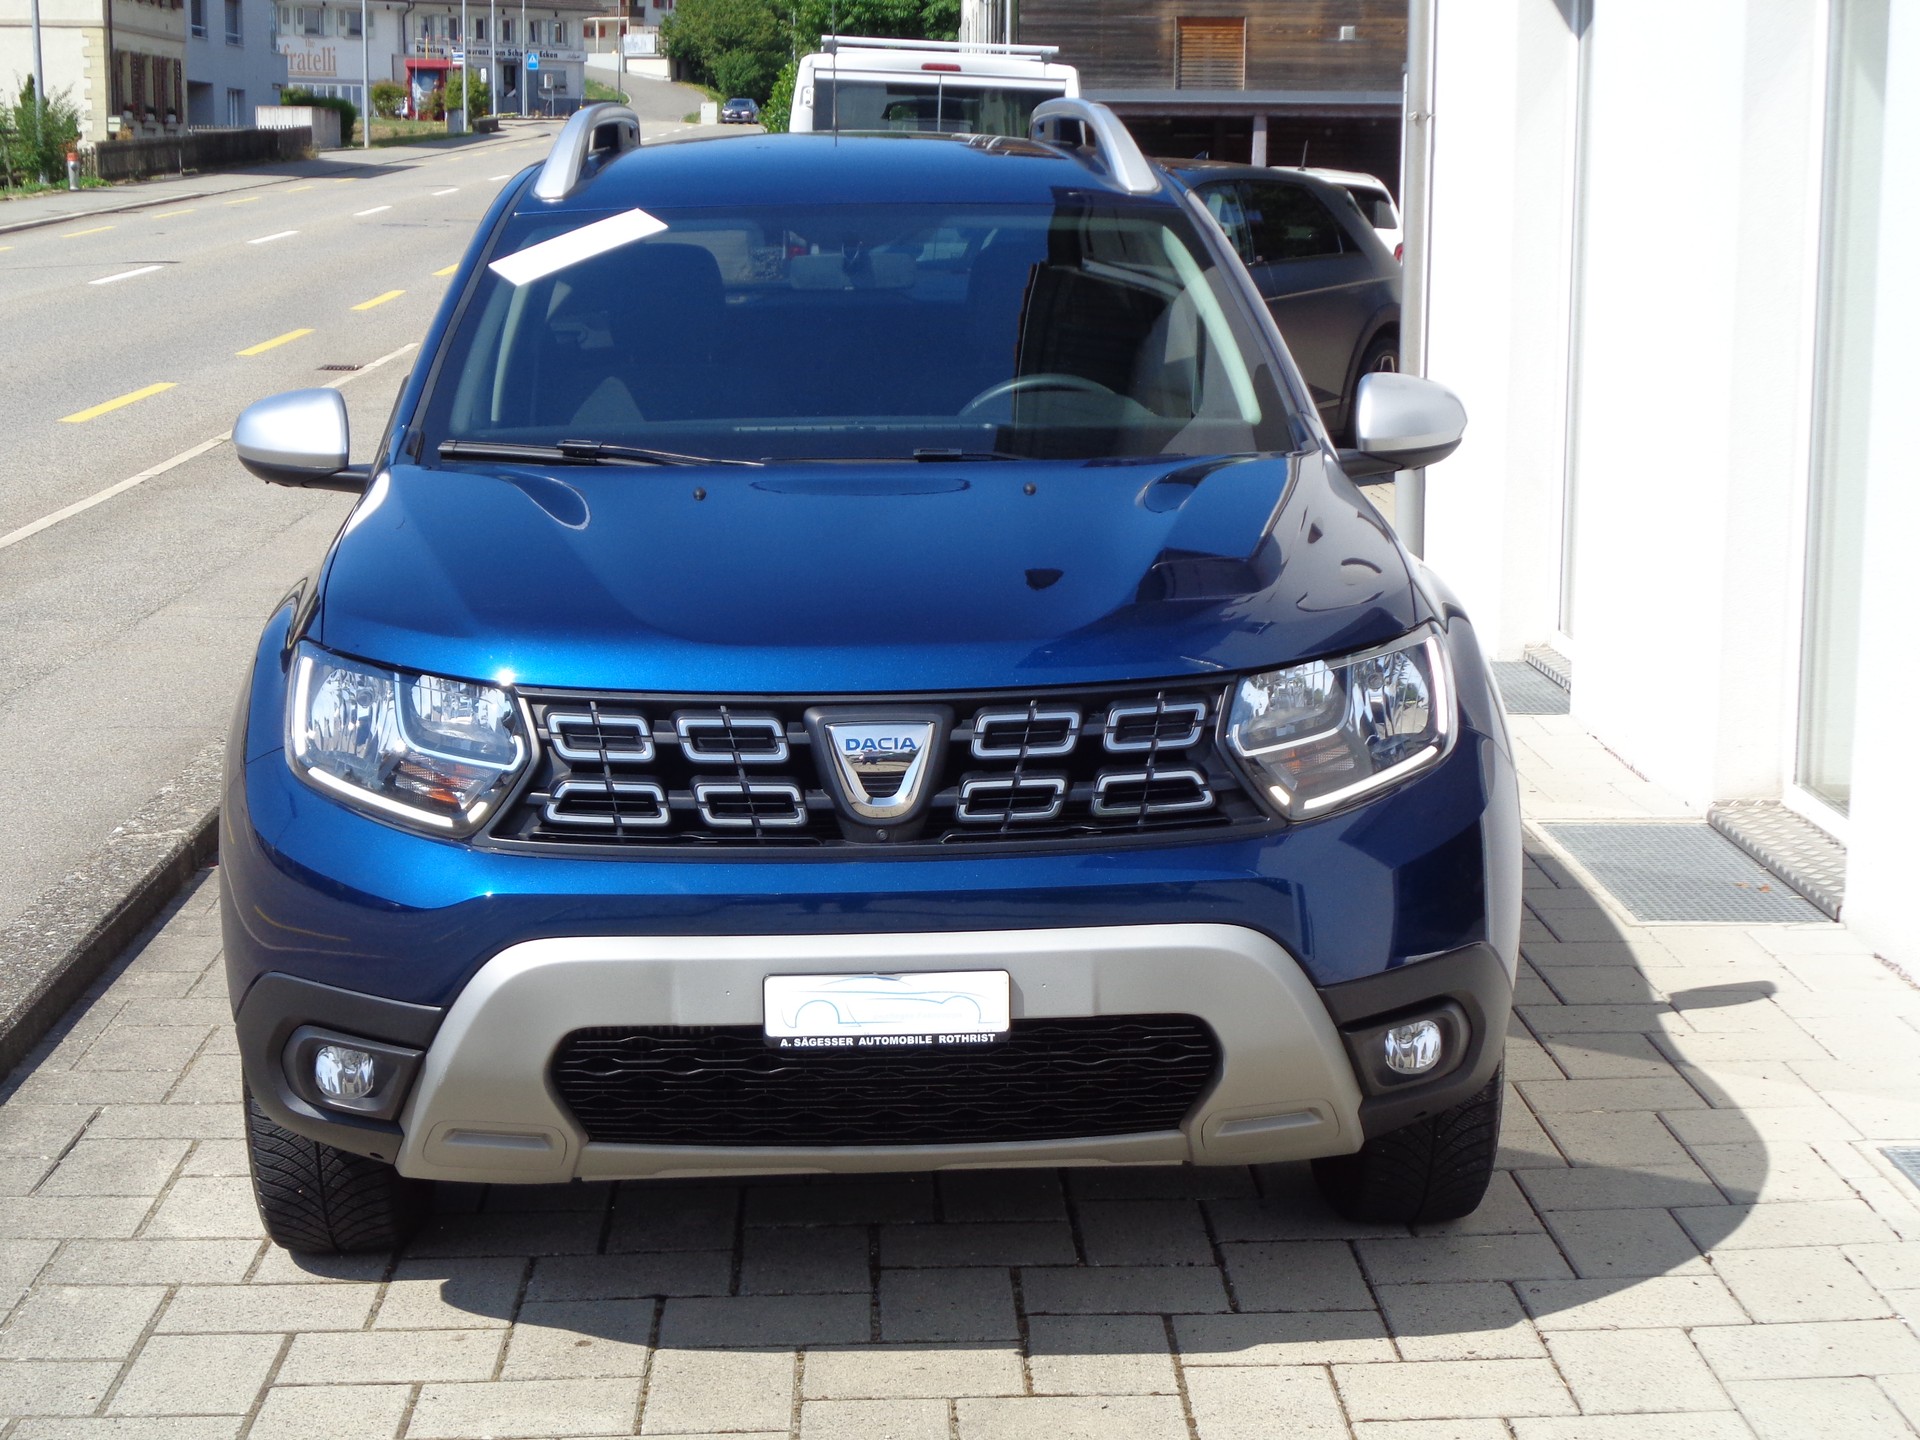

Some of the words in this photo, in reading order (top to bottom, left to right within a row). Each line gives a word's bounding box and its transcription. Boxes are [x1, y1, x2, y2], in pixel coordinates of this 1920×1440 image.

[539, 50, 558, 58] Ecken
[845, 737, 917, 751] DACIA
[779, 1039, 791, 1047] A.
[794, 1036, 853, 1046] SÄGESSER
[858, 1035, 932, 1045] AUTOMOBILE
[939, 1033, 995, 1043] ROTHRIST
